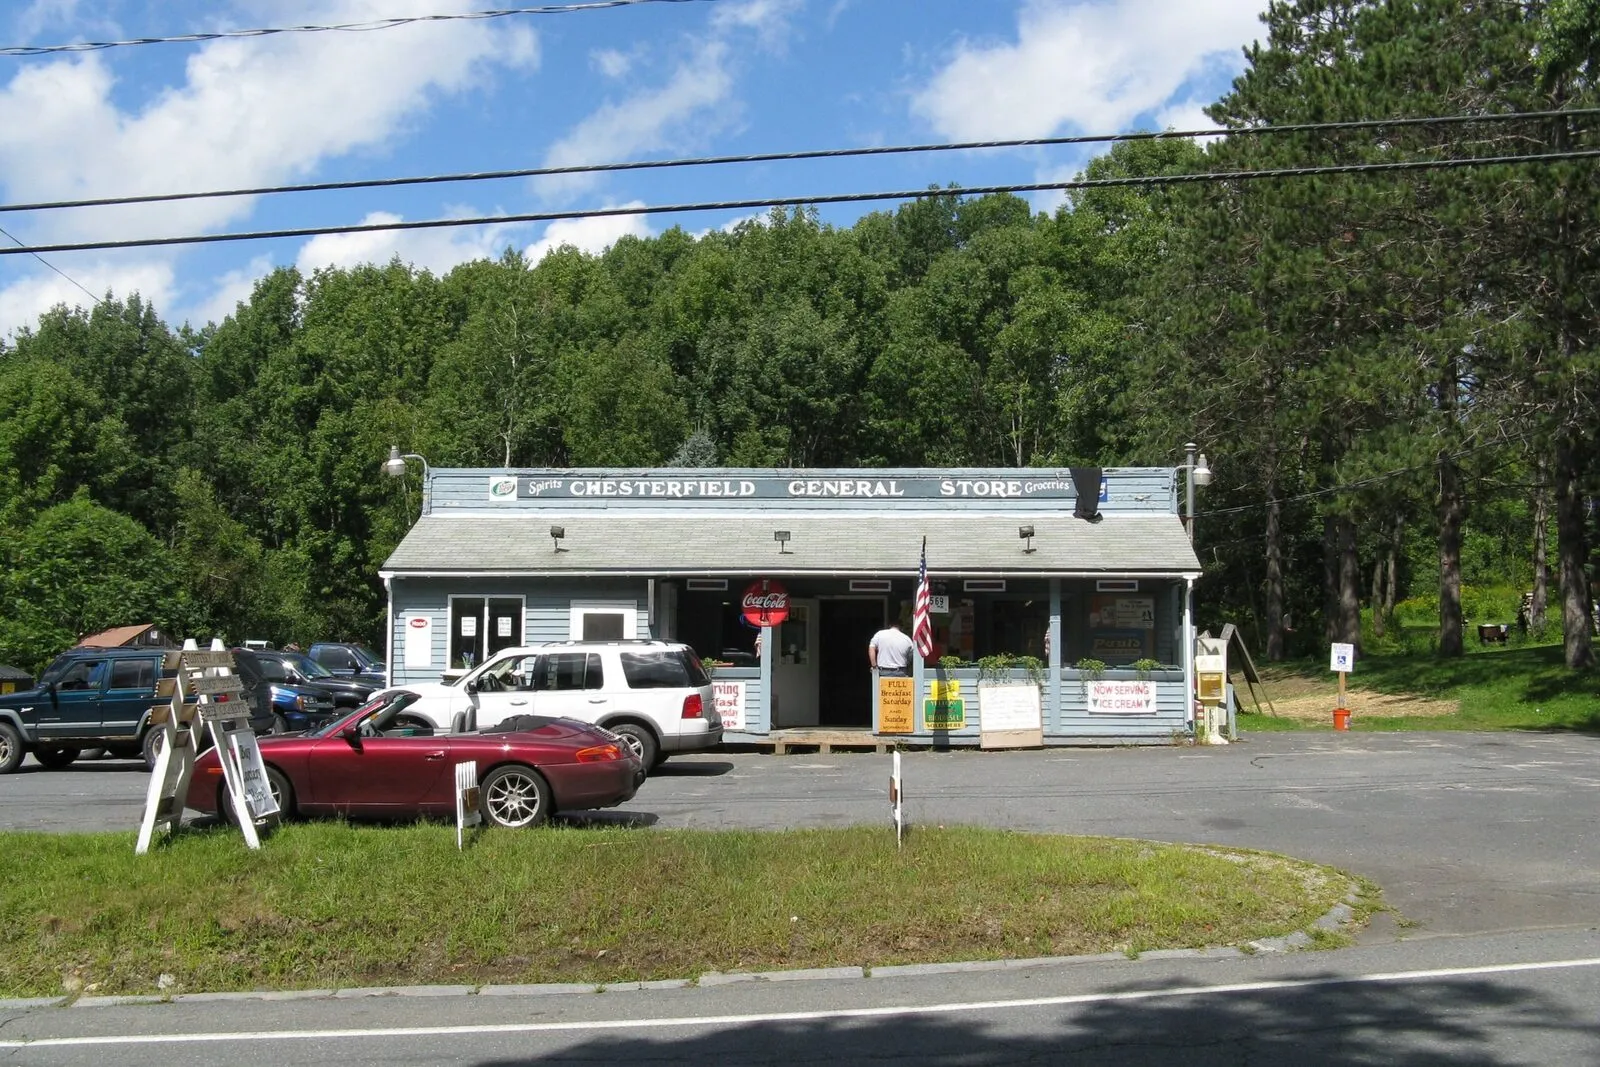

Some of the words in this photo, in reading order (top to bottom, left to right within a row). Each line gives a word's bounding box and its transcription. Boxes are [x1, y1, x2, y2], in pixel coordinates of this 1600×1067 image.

[528, 480, 563, 496] Spirits
[569, 480, 756, 497] CHESTERFIELD
[788, 480, 905, 498] GENERAL
[939, 480, 1022, 498] STORE
[1024, 480, 1070, 494] Groceries
[742, 593, 789, 608] Coca-Cola
[712, 682, 739, 698] rving
[1093, 686, 1113, 695] NOW
[1115, 686, 1149, 695] SERVING
[714, 697, 738, 706] fast
[883, 698, 912, 706] Saturday
[1099, 700, 1113, 708] ICE
[1115, 699, 1143, 709] CREAM
[885, 716, 908, 724] Sunday
